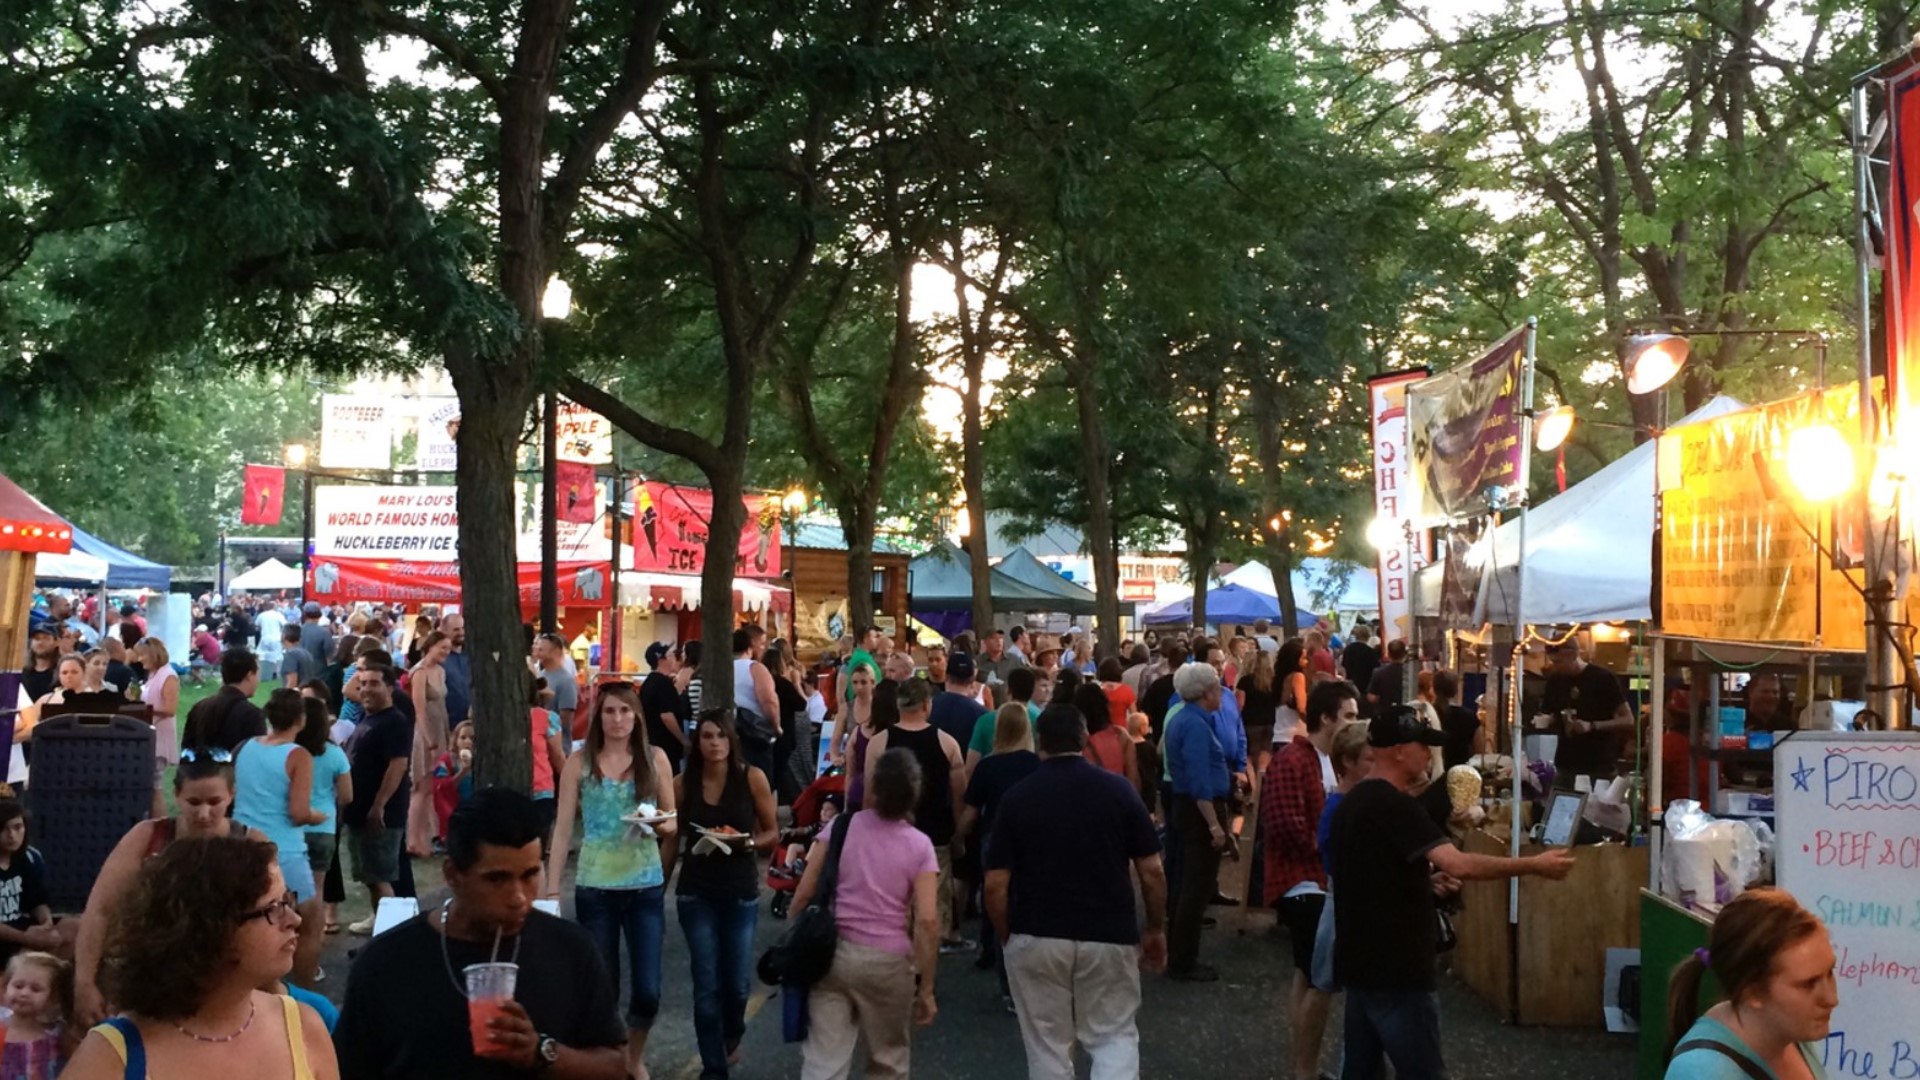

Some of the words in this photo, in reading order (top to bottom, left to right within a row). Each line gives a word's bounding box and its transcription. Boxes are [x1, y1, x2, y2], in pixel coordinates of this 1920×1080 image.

[378, 495, 413, 506] MARY
[416, 495, 454, 506] LOU'S
[328, 513, 372, 526] WORLD
[374, 513, 427, 526] FAMOUS
[334, 536, 428, 550] HUCKLEBERRY
[429, 537, 452, 550] ICE
[668, 549, 698, 570] ICE
[1824, 754, 1917, 805] PIRO
[1817, 894, 1902, 928] SALMON
[1823, 1031, 1878, 1078] The
[1889, 1041, 1920, 1080] B
